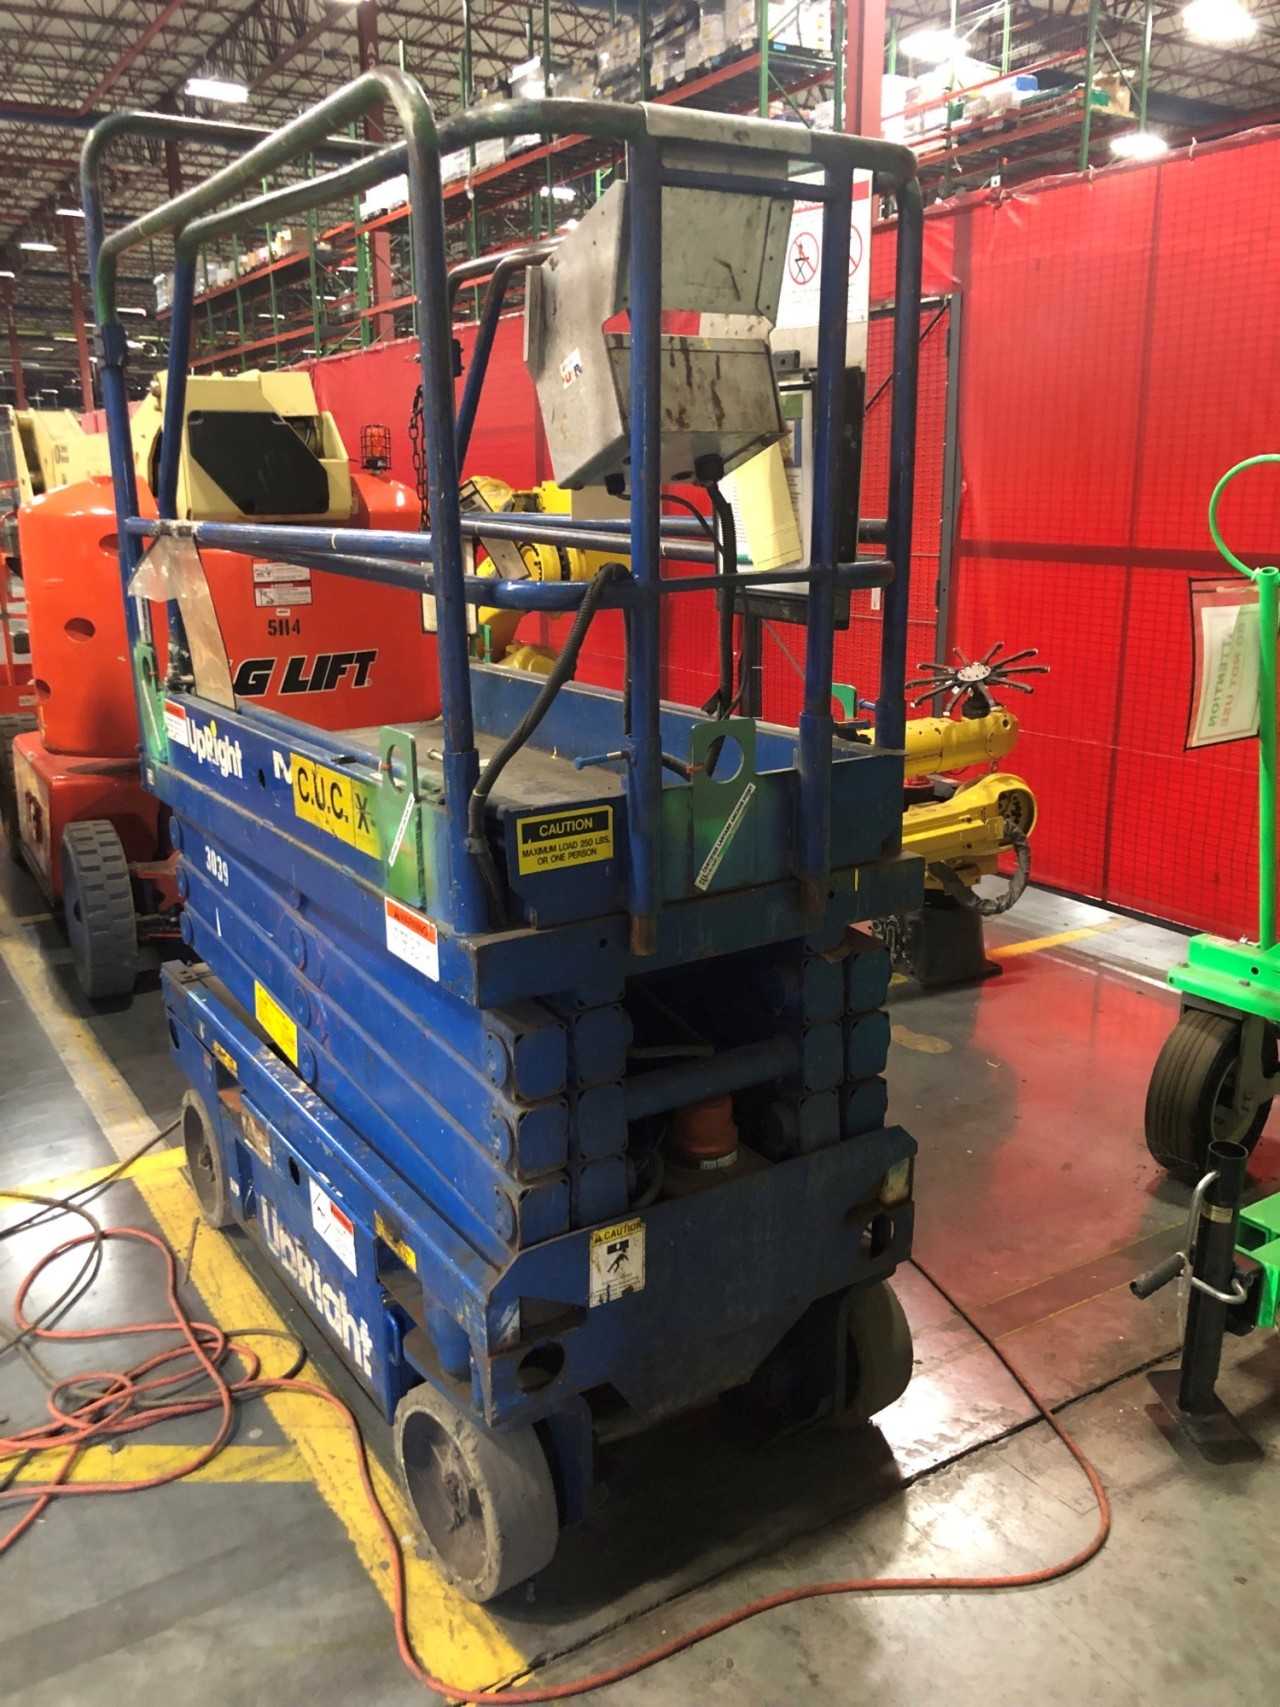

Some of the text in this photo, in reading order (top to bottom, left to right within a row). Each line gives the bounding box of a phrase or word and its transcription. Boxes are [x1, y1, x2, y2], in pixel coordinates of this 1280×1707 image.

[267, 619, 301, 636] 5114
[278, 648, 379, 696] LIFT
[185, 718, 243, 779] UpRight
[539, 817, 594, 838] CAUTION
[522, 844, 557, 858] MAXIMUM
[558, 841, 578, 852] LOAD
[536, 848, 597, 866] OR ONE PERSON
[205, 846, 229, 888] 3039
[604, 1222, 642, 1240] CAUTION
